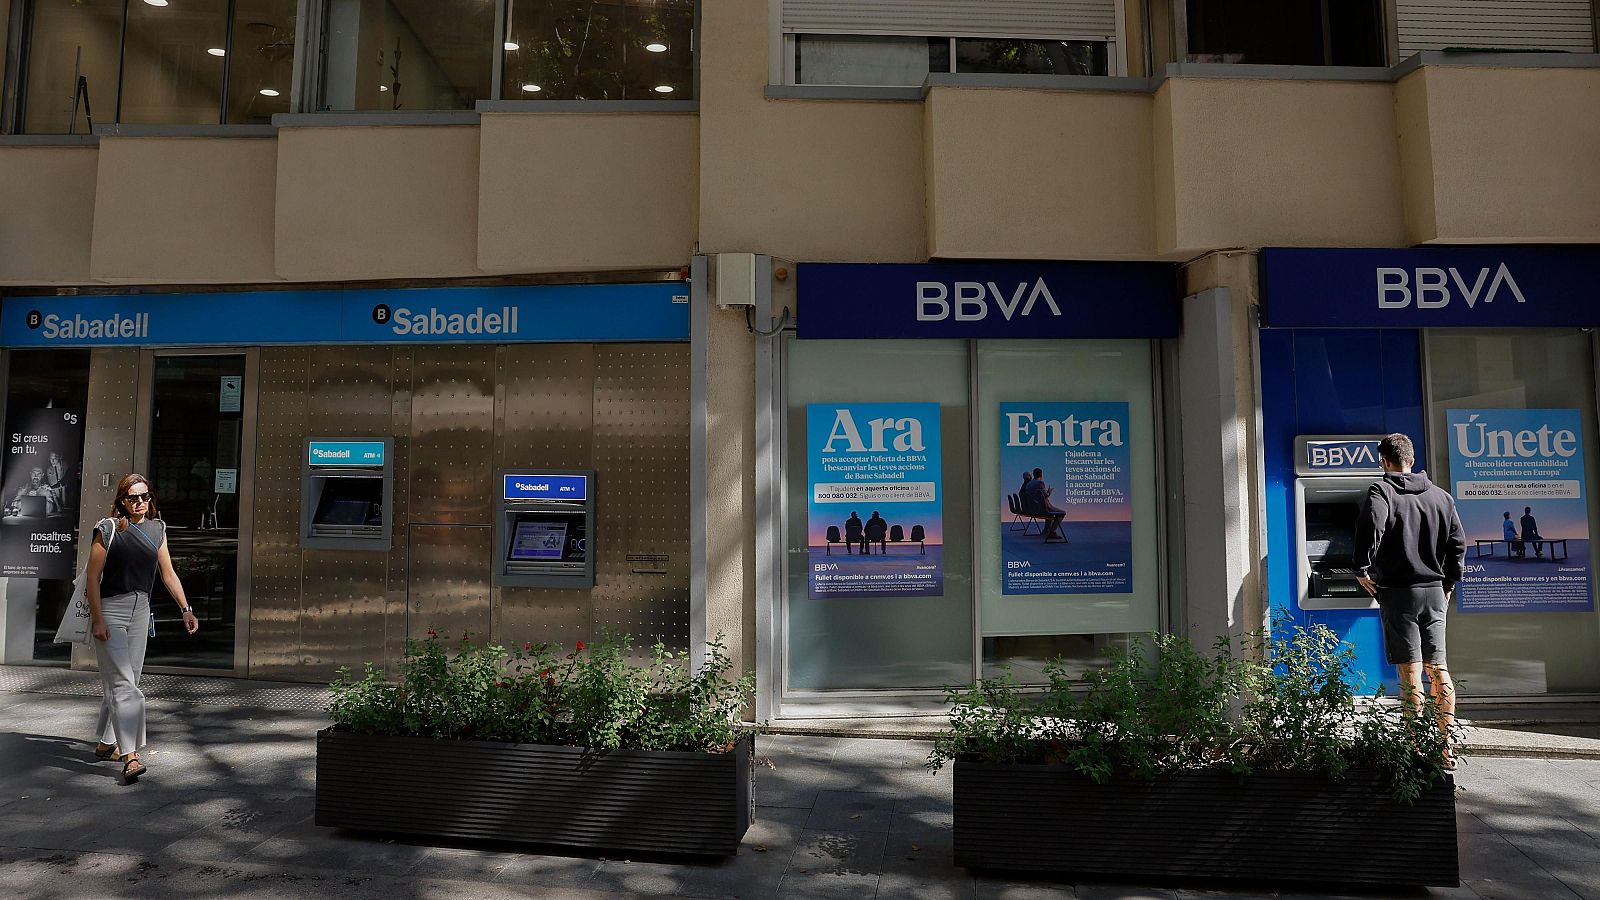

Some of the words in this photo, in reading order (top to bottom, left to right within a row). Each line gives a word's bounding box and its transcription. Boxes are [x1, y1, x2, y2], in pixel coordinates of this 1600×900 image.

[1377, 262, 1525, 308] BBVA
[917, 277, 1061, 321] BBVA
[392, 307, 518, 334] Sabadell
[43, 313, 148, 339] Sabadell
[822, 409, 926, 452] Ara
[1006, 413, 1123, 446] Entra
[12, 433, 22, 443] Si
[24, 434, 48, 443] creus
[1454, 414, 1576, 457] Únete
[12, 446, 23, 454] en
[26, 445, 37, 455] tu,
[318, 450, 350, 458] Sabadell
[822, 456, 838, 464] pots
[1312, 445, 1375, 466] BBVA
[1465, 460, 1472, 468] al
[1472, 460, 1495, 468] banco
[1066, 496, 1087, 504] Siguis
[31, 532, 71, 541] nosaltres
[30, 543, 62, 553] també.
[814, 563, 839, 572] BBVA
